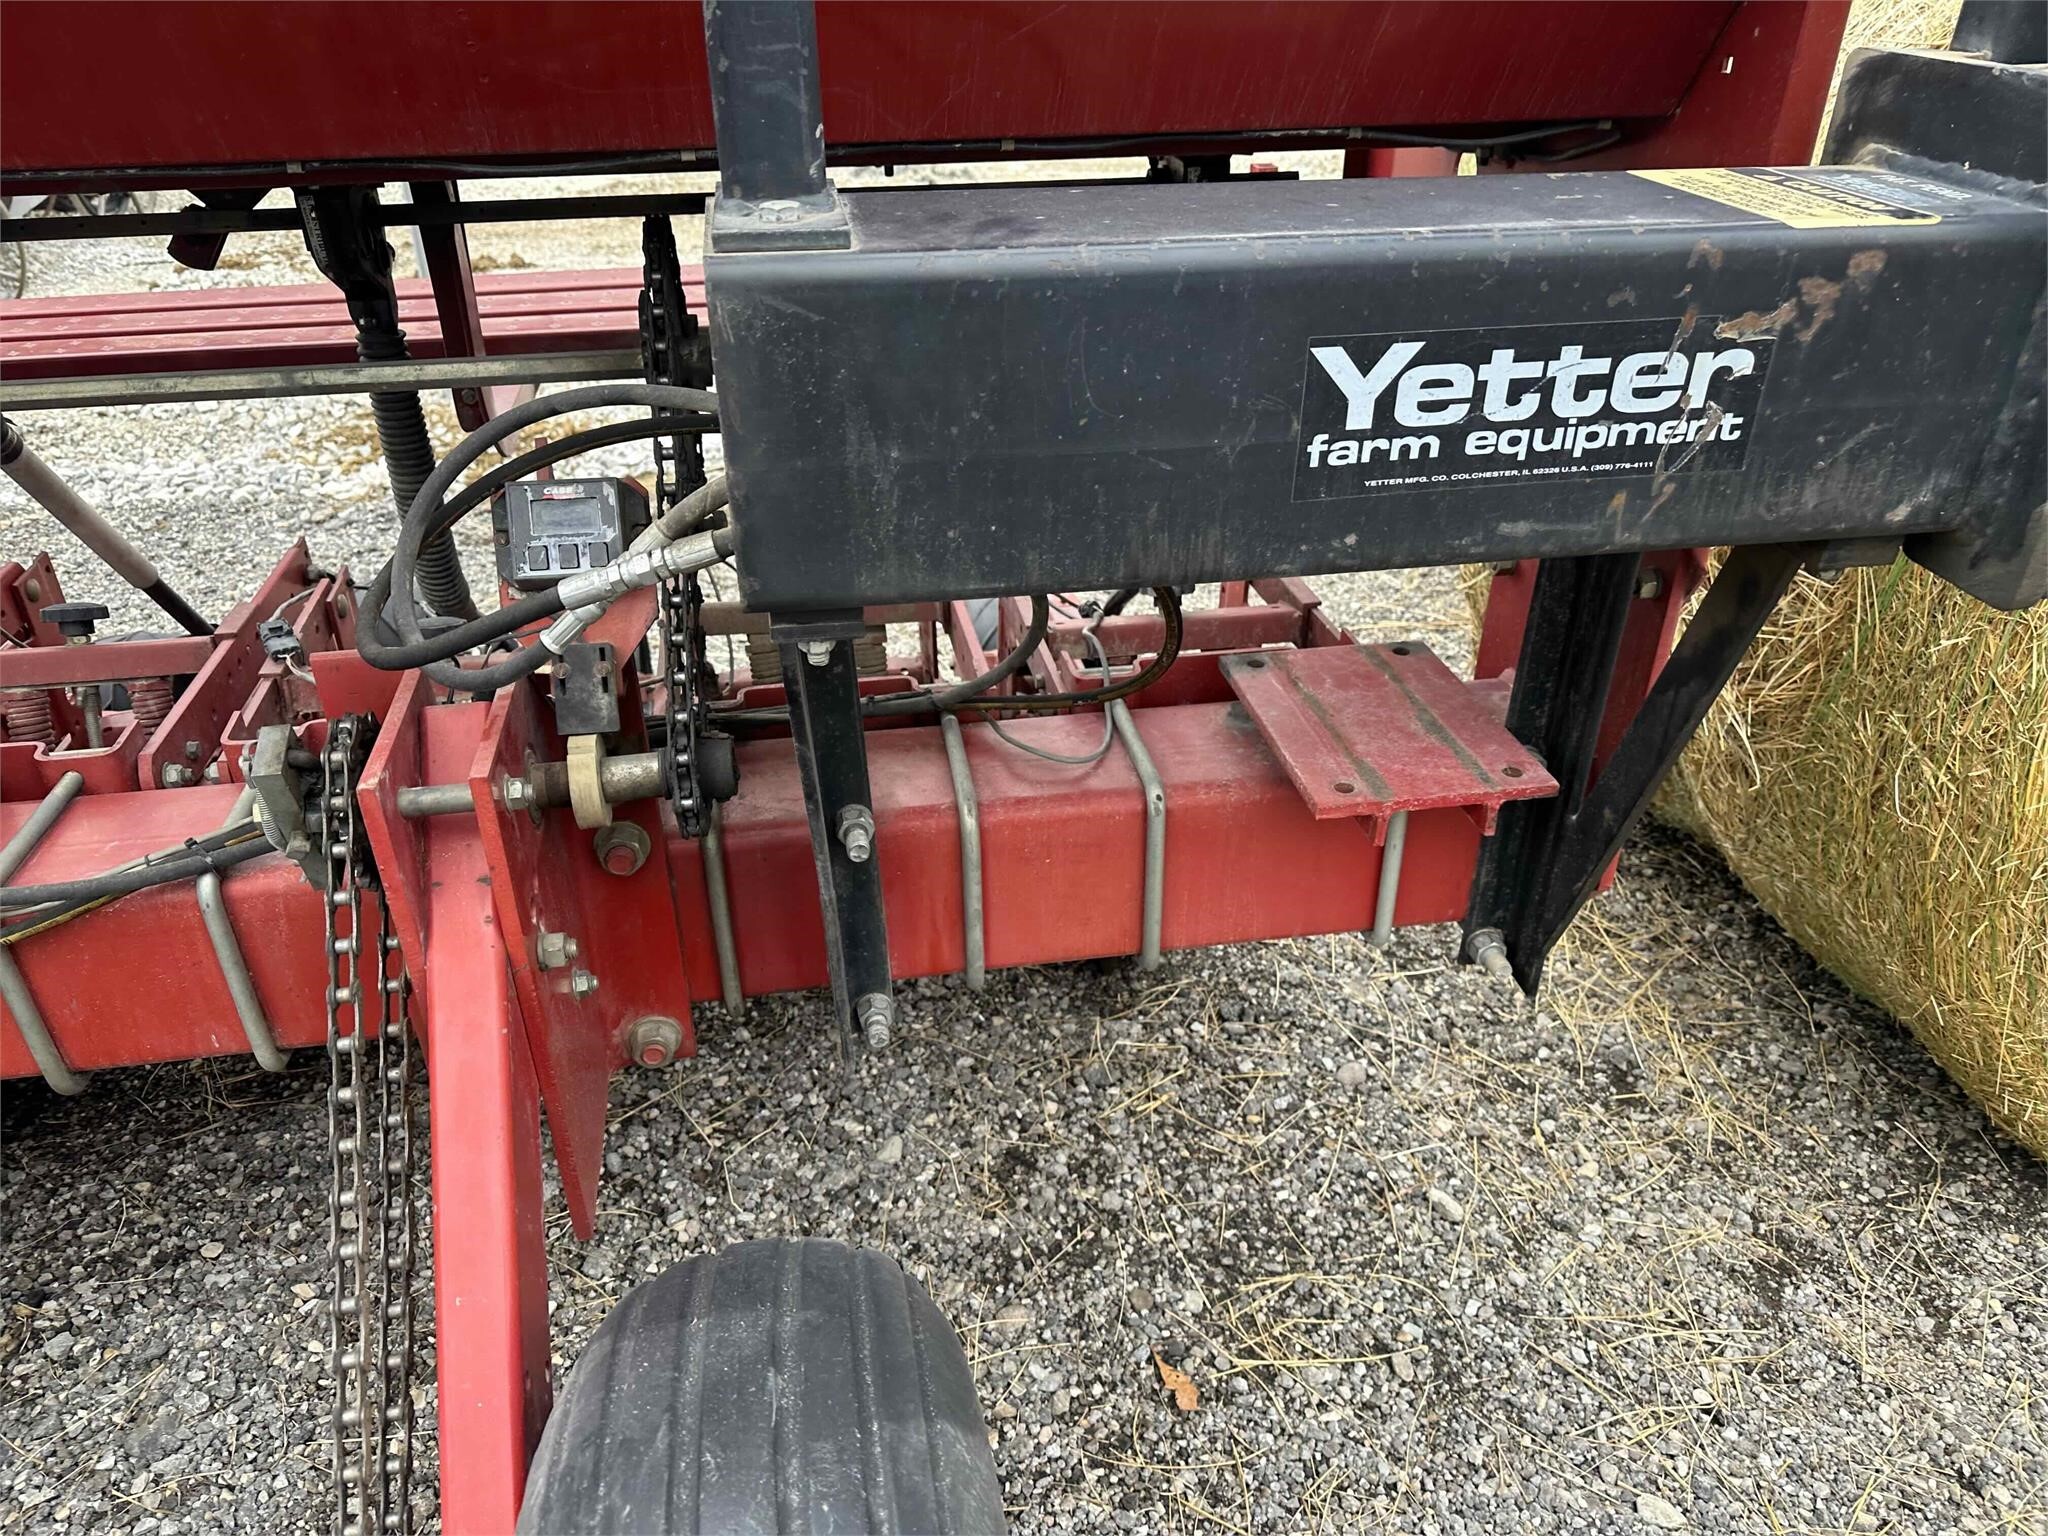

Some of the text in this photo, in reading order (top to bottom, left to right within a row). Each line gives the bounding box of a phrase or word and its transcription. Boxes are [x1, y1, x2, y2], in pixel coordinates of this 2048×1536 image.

[1782, 180, 1897, 211] CAUTION
[1310, 341, 1755, 431] Yetter
[1306, 434, 1440, 468] farm
[1465, 412, 1744, 460] equipment
[1363, 461, 1654, 487] YETTER MFG. CO. COLCHESTER, IL 62326 U.S.A. (309) 776-4111
